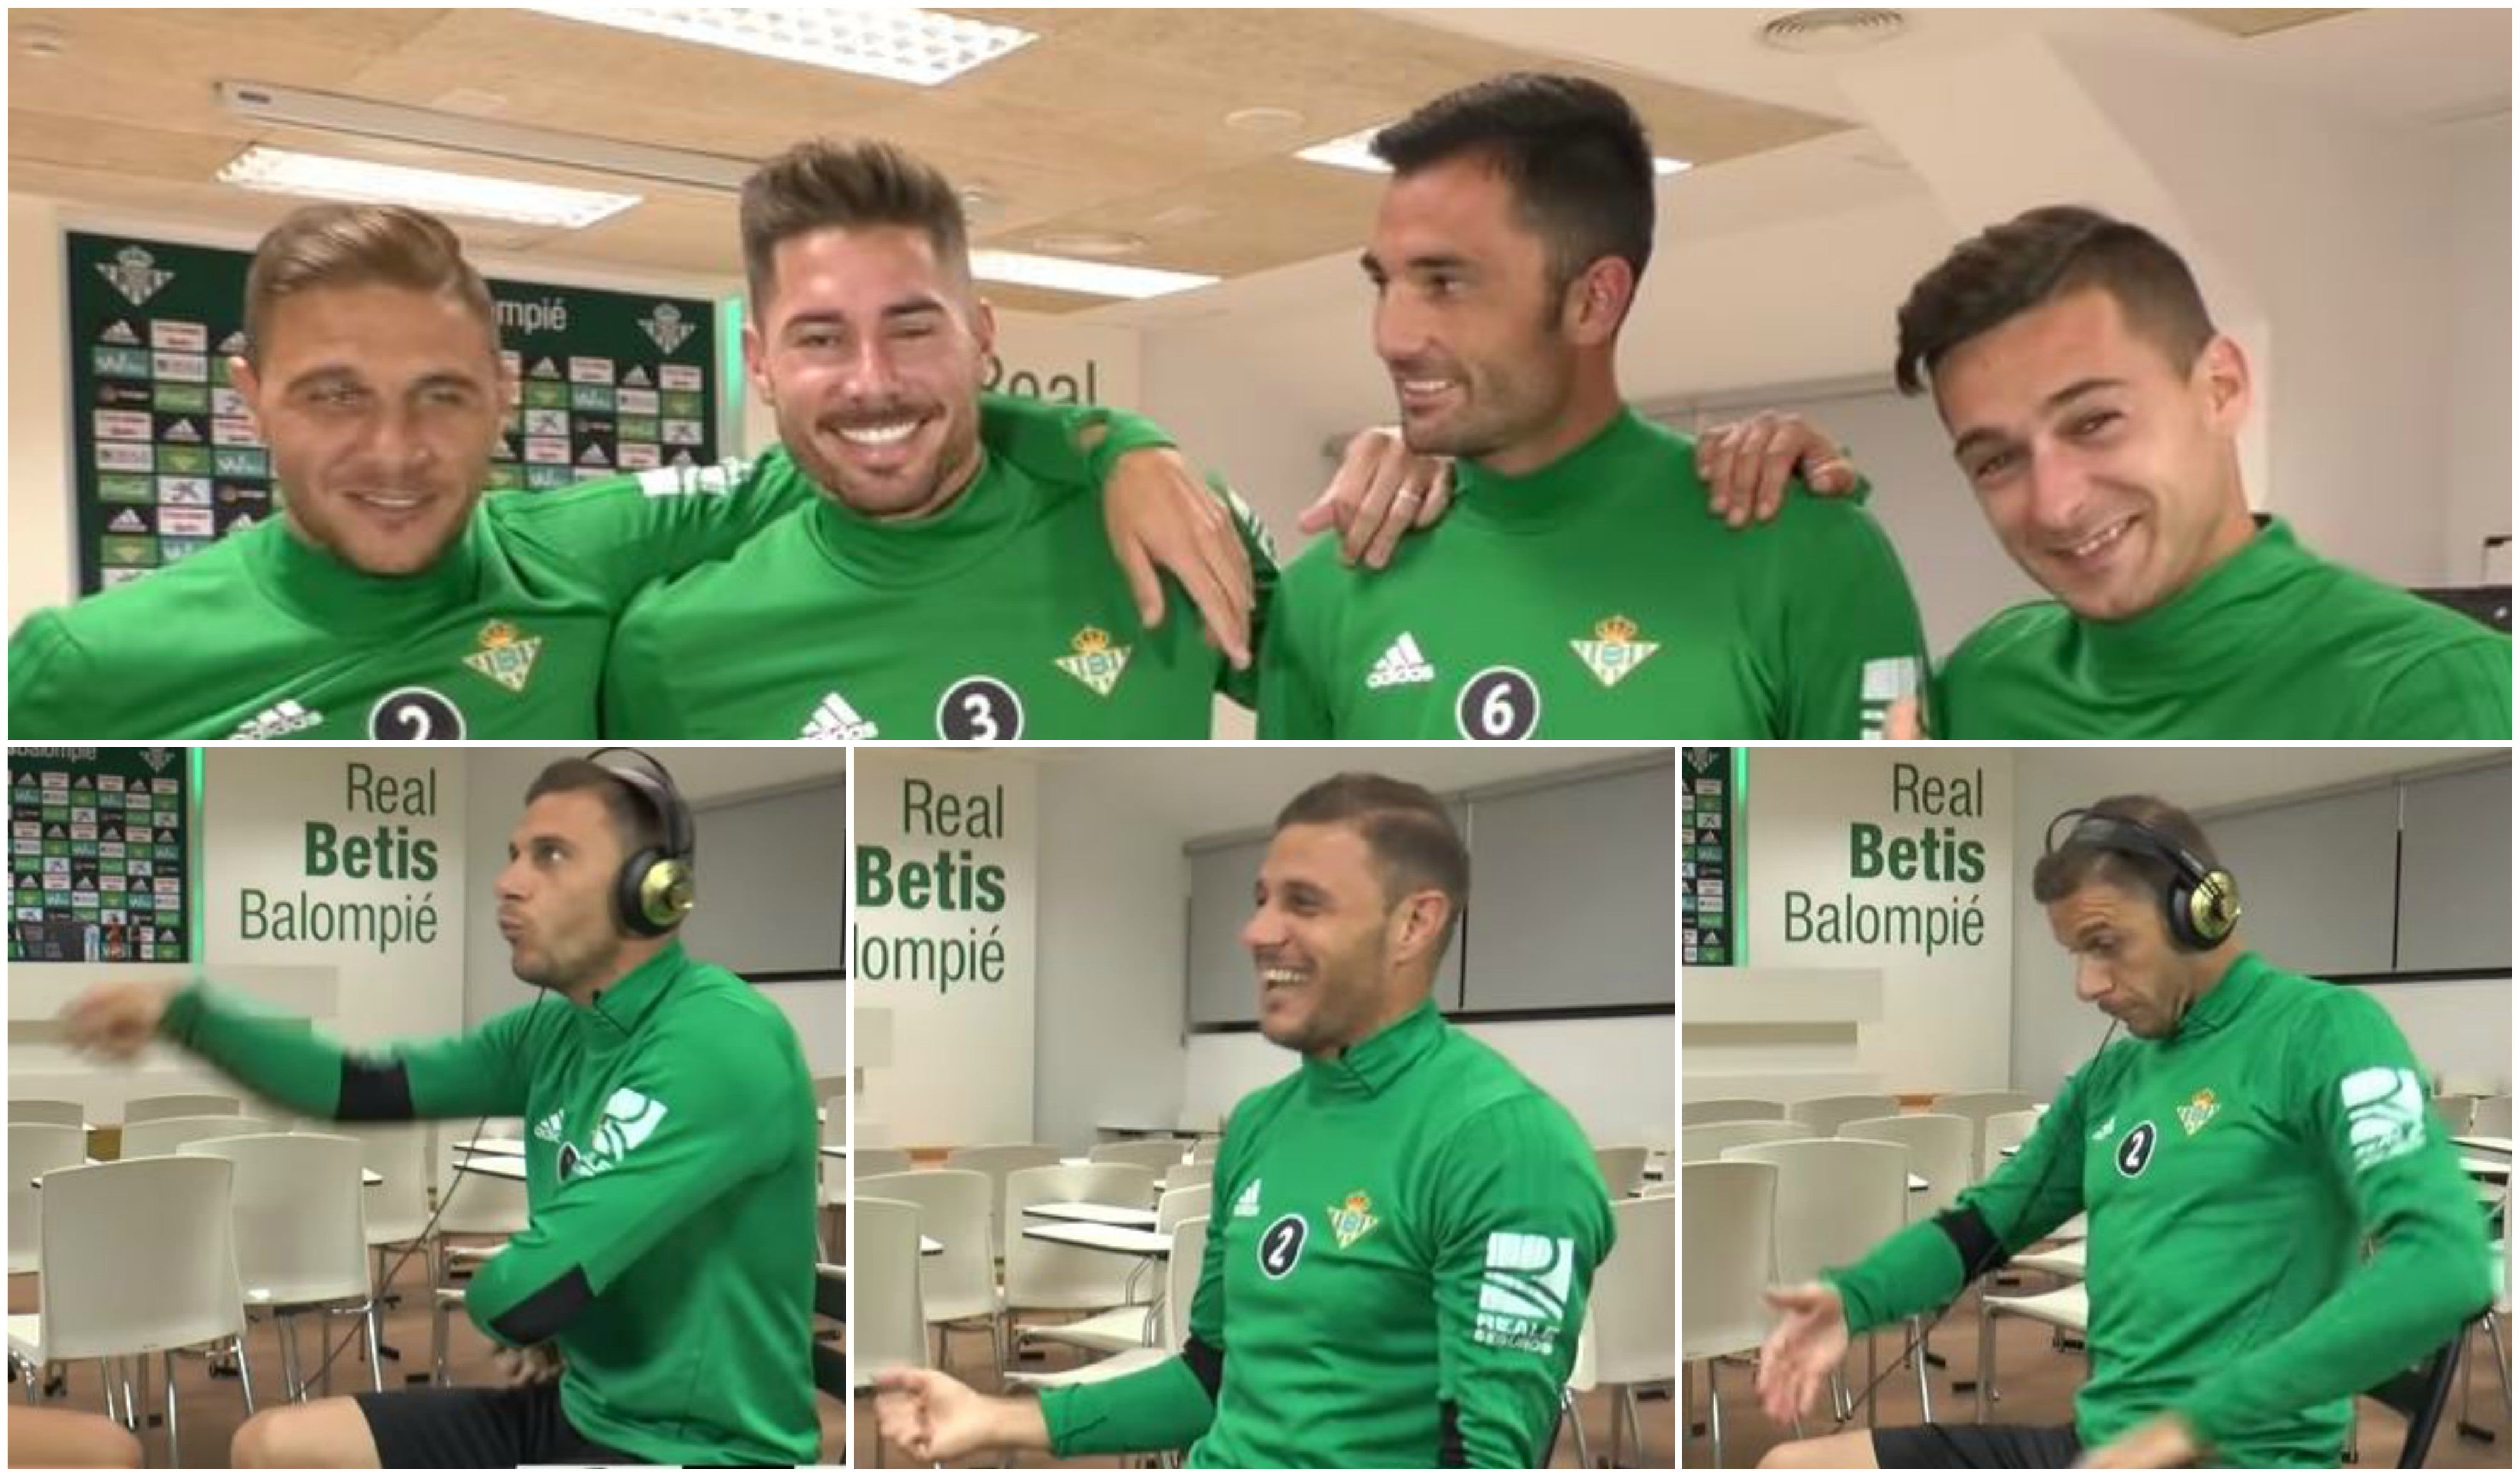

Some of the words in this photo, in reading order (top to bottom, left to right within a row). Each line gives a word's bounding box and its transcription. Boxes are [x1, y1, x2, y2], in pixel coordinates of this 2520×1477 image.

[491, 297, 567, 335] mpié
[398, 705, 431, 740] 2
[963, 694, 999, 740] 3
[1482, 683, 1515, 735] 6
[347, 762, 436, 817] Real
[903, 778, 1004, 839] Real
[1893, 763, 1983, 817] Real
[305, 821, 438, 882] Betis
[856, 845, 1005, 912] Betis
[1850, 822, 1985, 883] Betis
[241, 889, 437, 953] Balompié
[1785, 890, 1984, 956] Balompié
[2125, 1130, 2145, 1167] 2
[1268, 1226, 1294, 1268] 2
